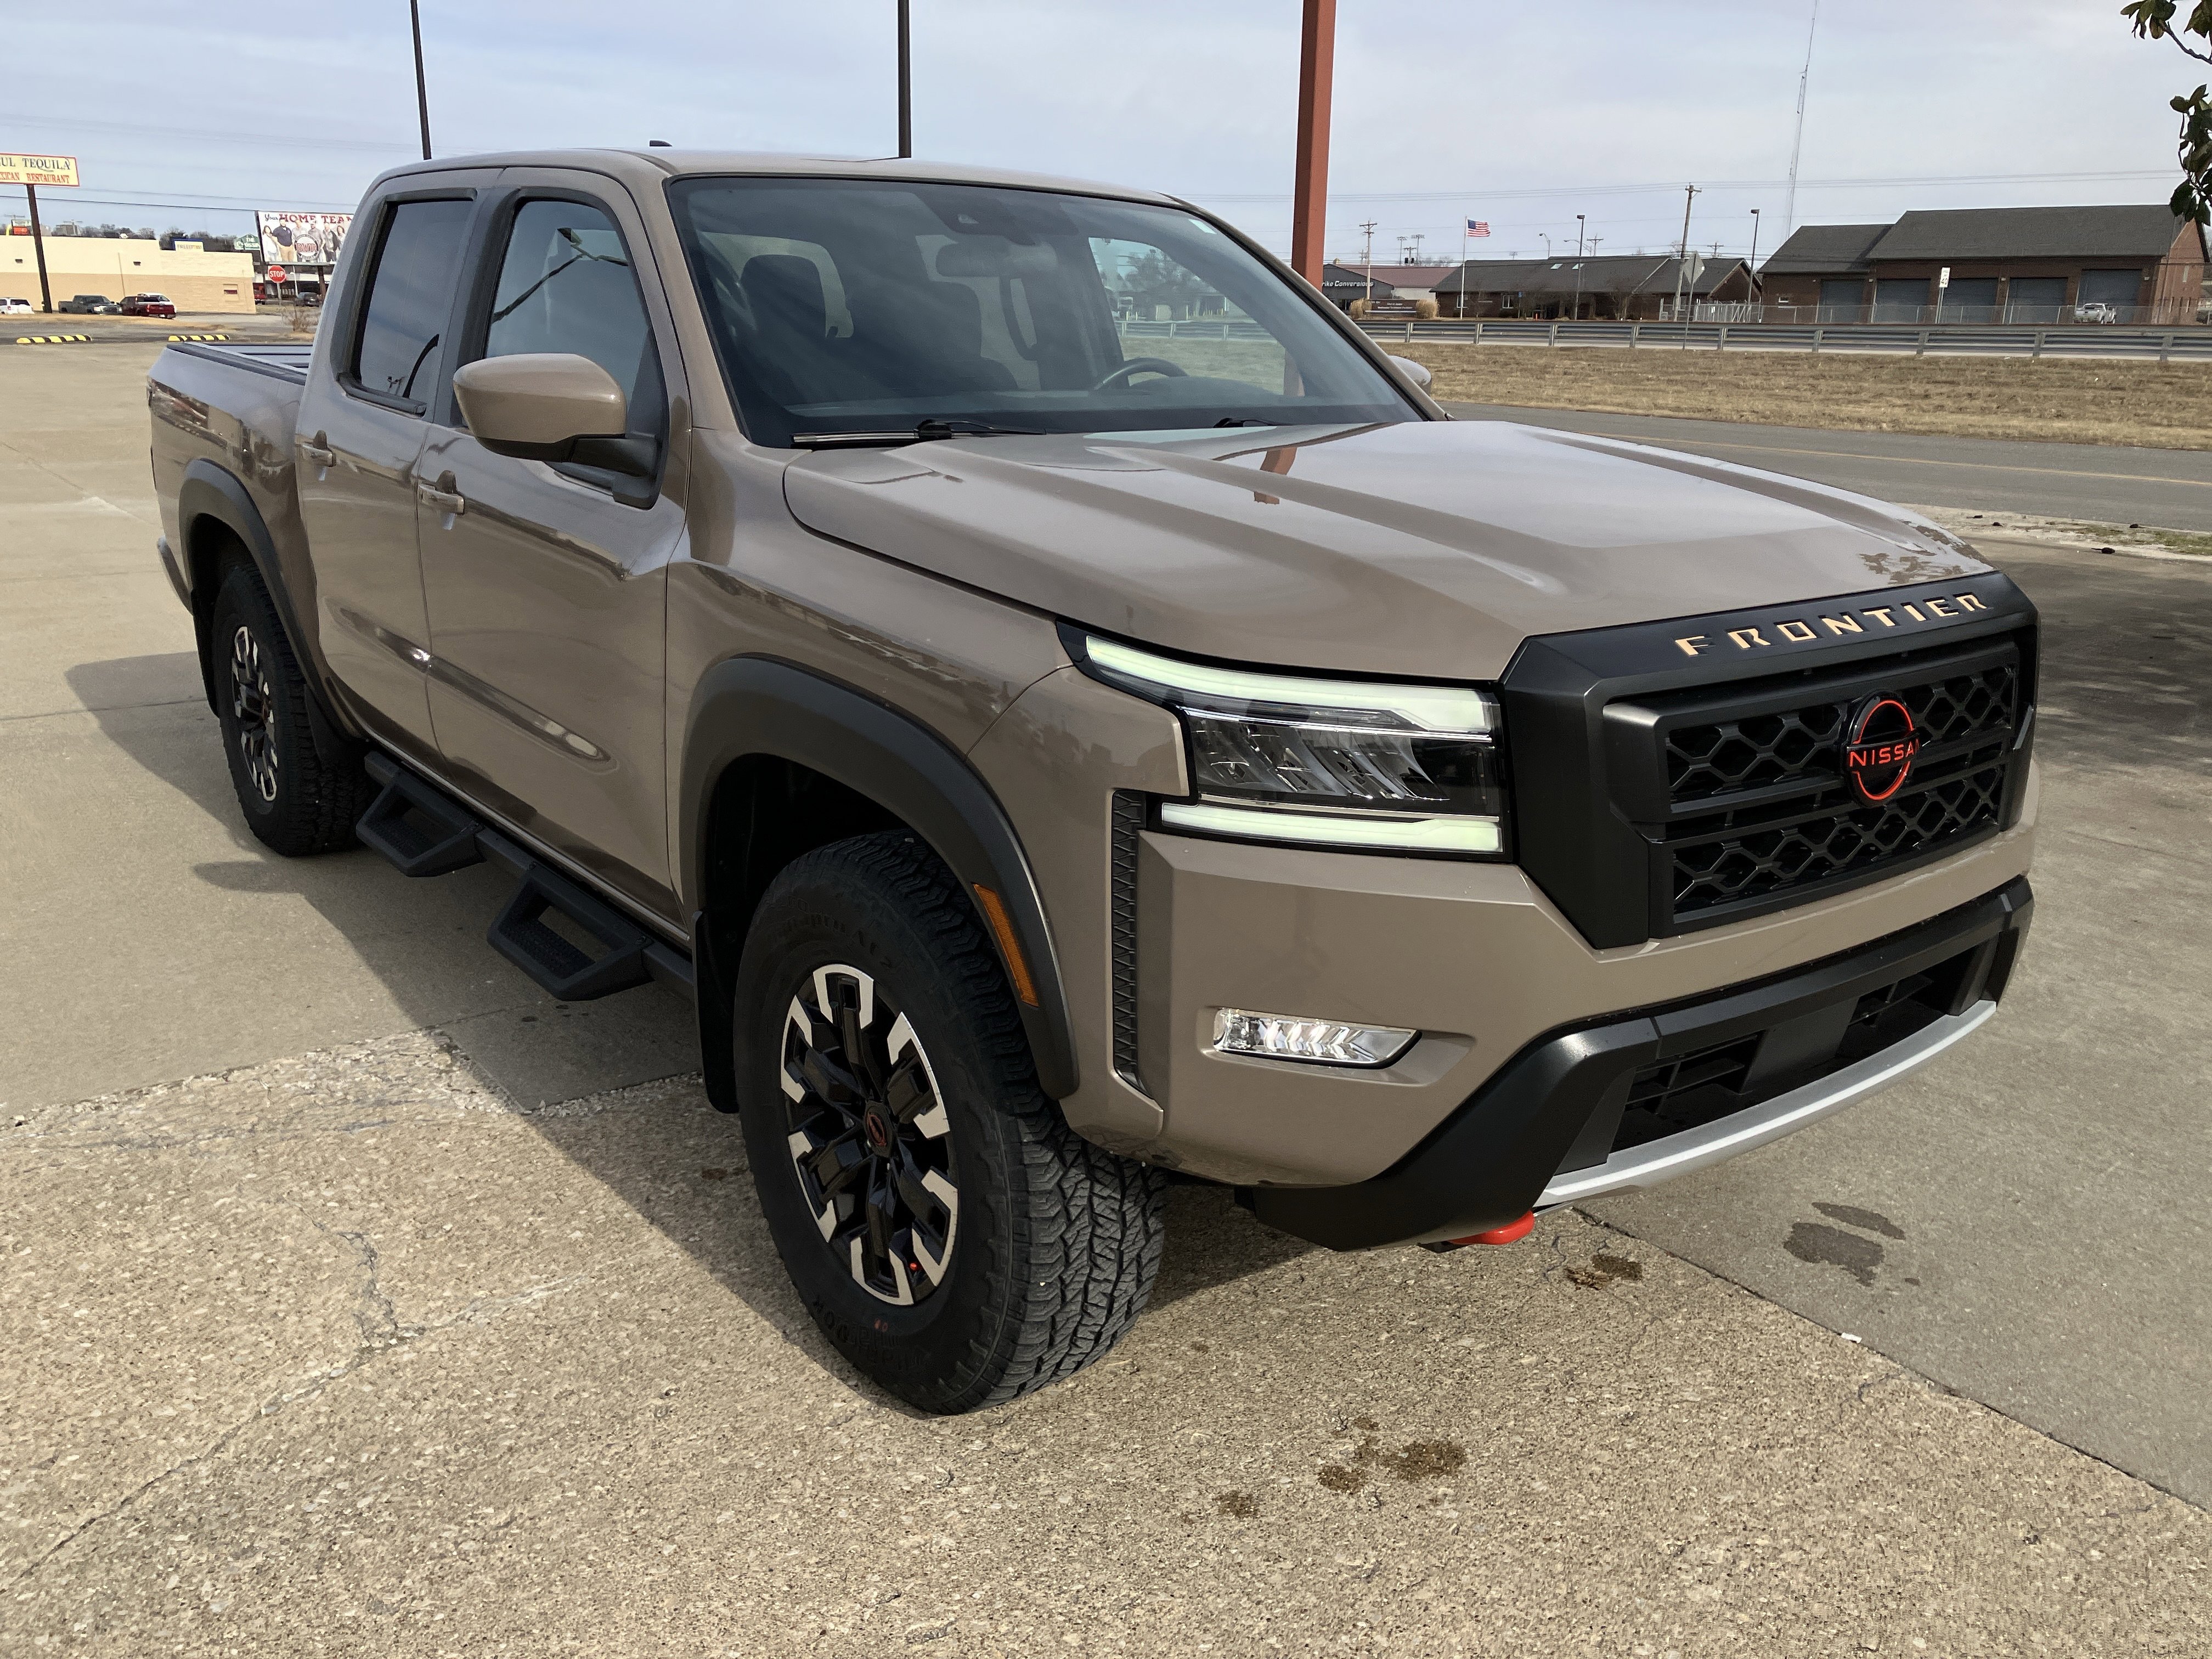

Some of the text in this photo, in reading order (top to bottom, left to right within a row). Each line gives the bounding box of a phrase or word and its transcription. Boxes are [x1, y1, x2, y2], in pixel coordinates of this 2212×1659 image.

[22, 158, 70, 172] TEQUILA
[26, 173, 69, 183] RESTAURANT
[279, 214, 316, 223] HOME
[1675, 592, 1987, 657] FRONTIER
